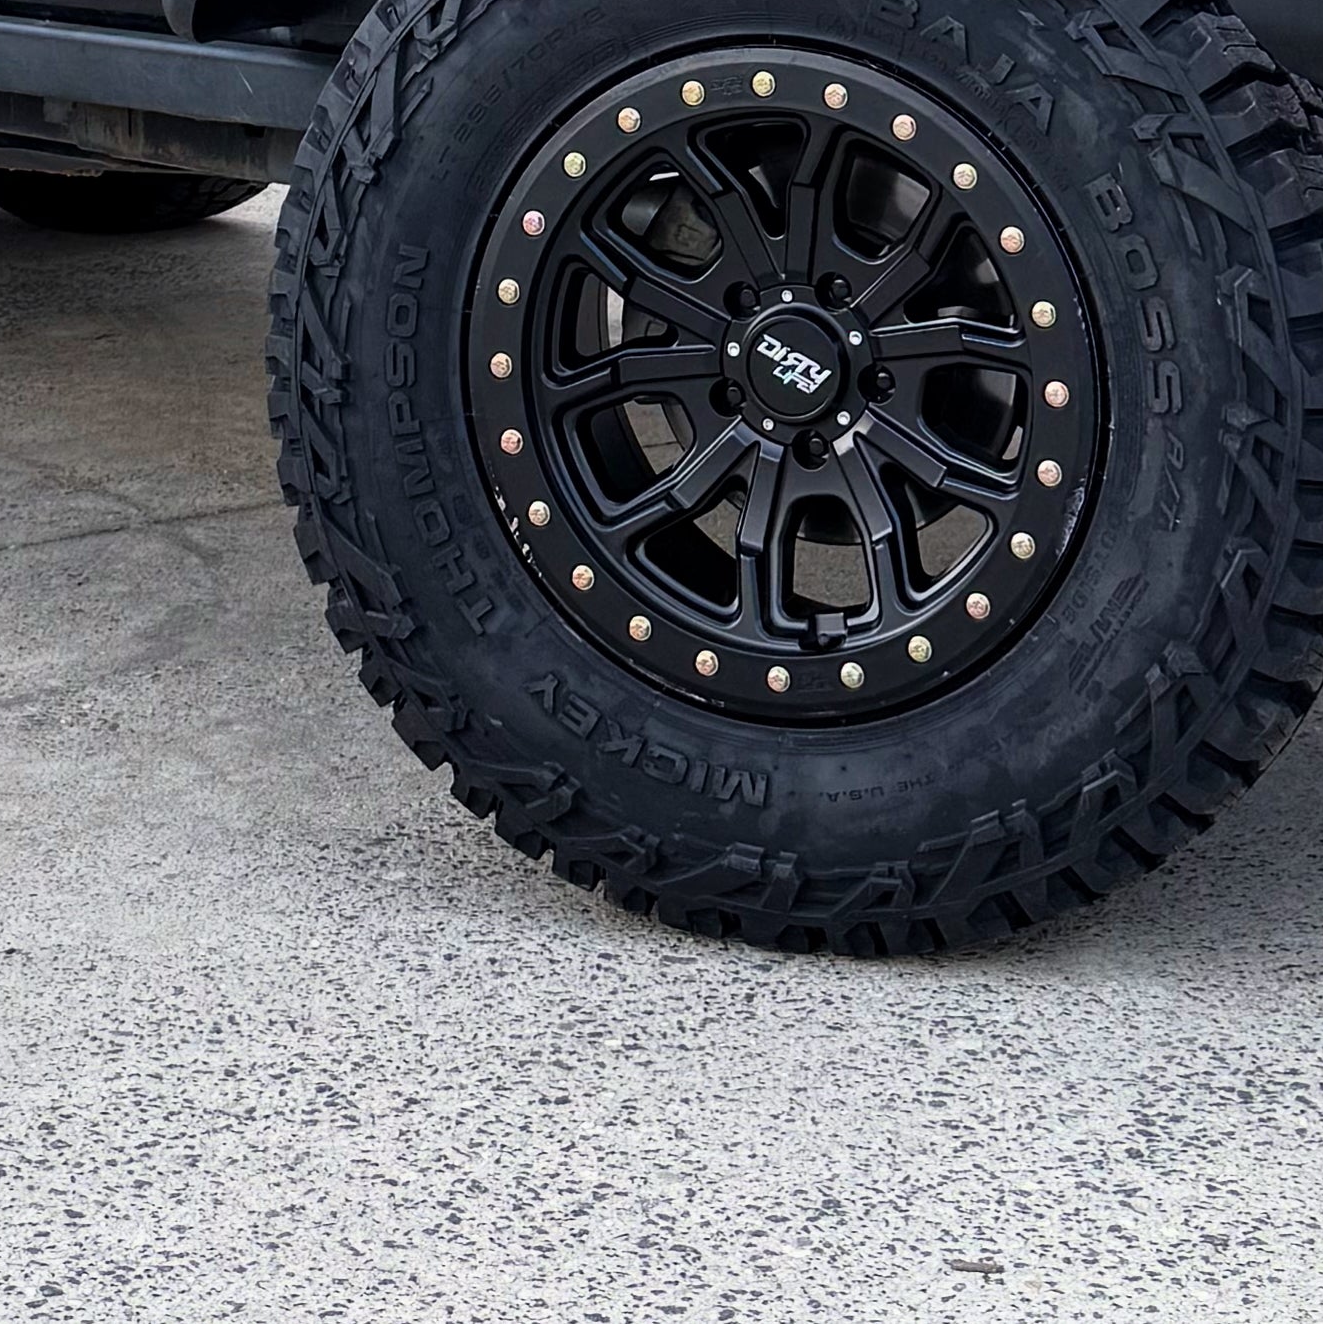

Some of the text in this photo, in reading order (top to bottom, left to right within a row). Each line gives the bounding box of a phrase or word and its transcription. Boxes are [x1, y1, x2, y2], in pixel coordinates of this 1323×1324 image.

[1084, 171, 1185, 416] BOSS
[383, 242, 770, 810] MICKEY THOMPSON
